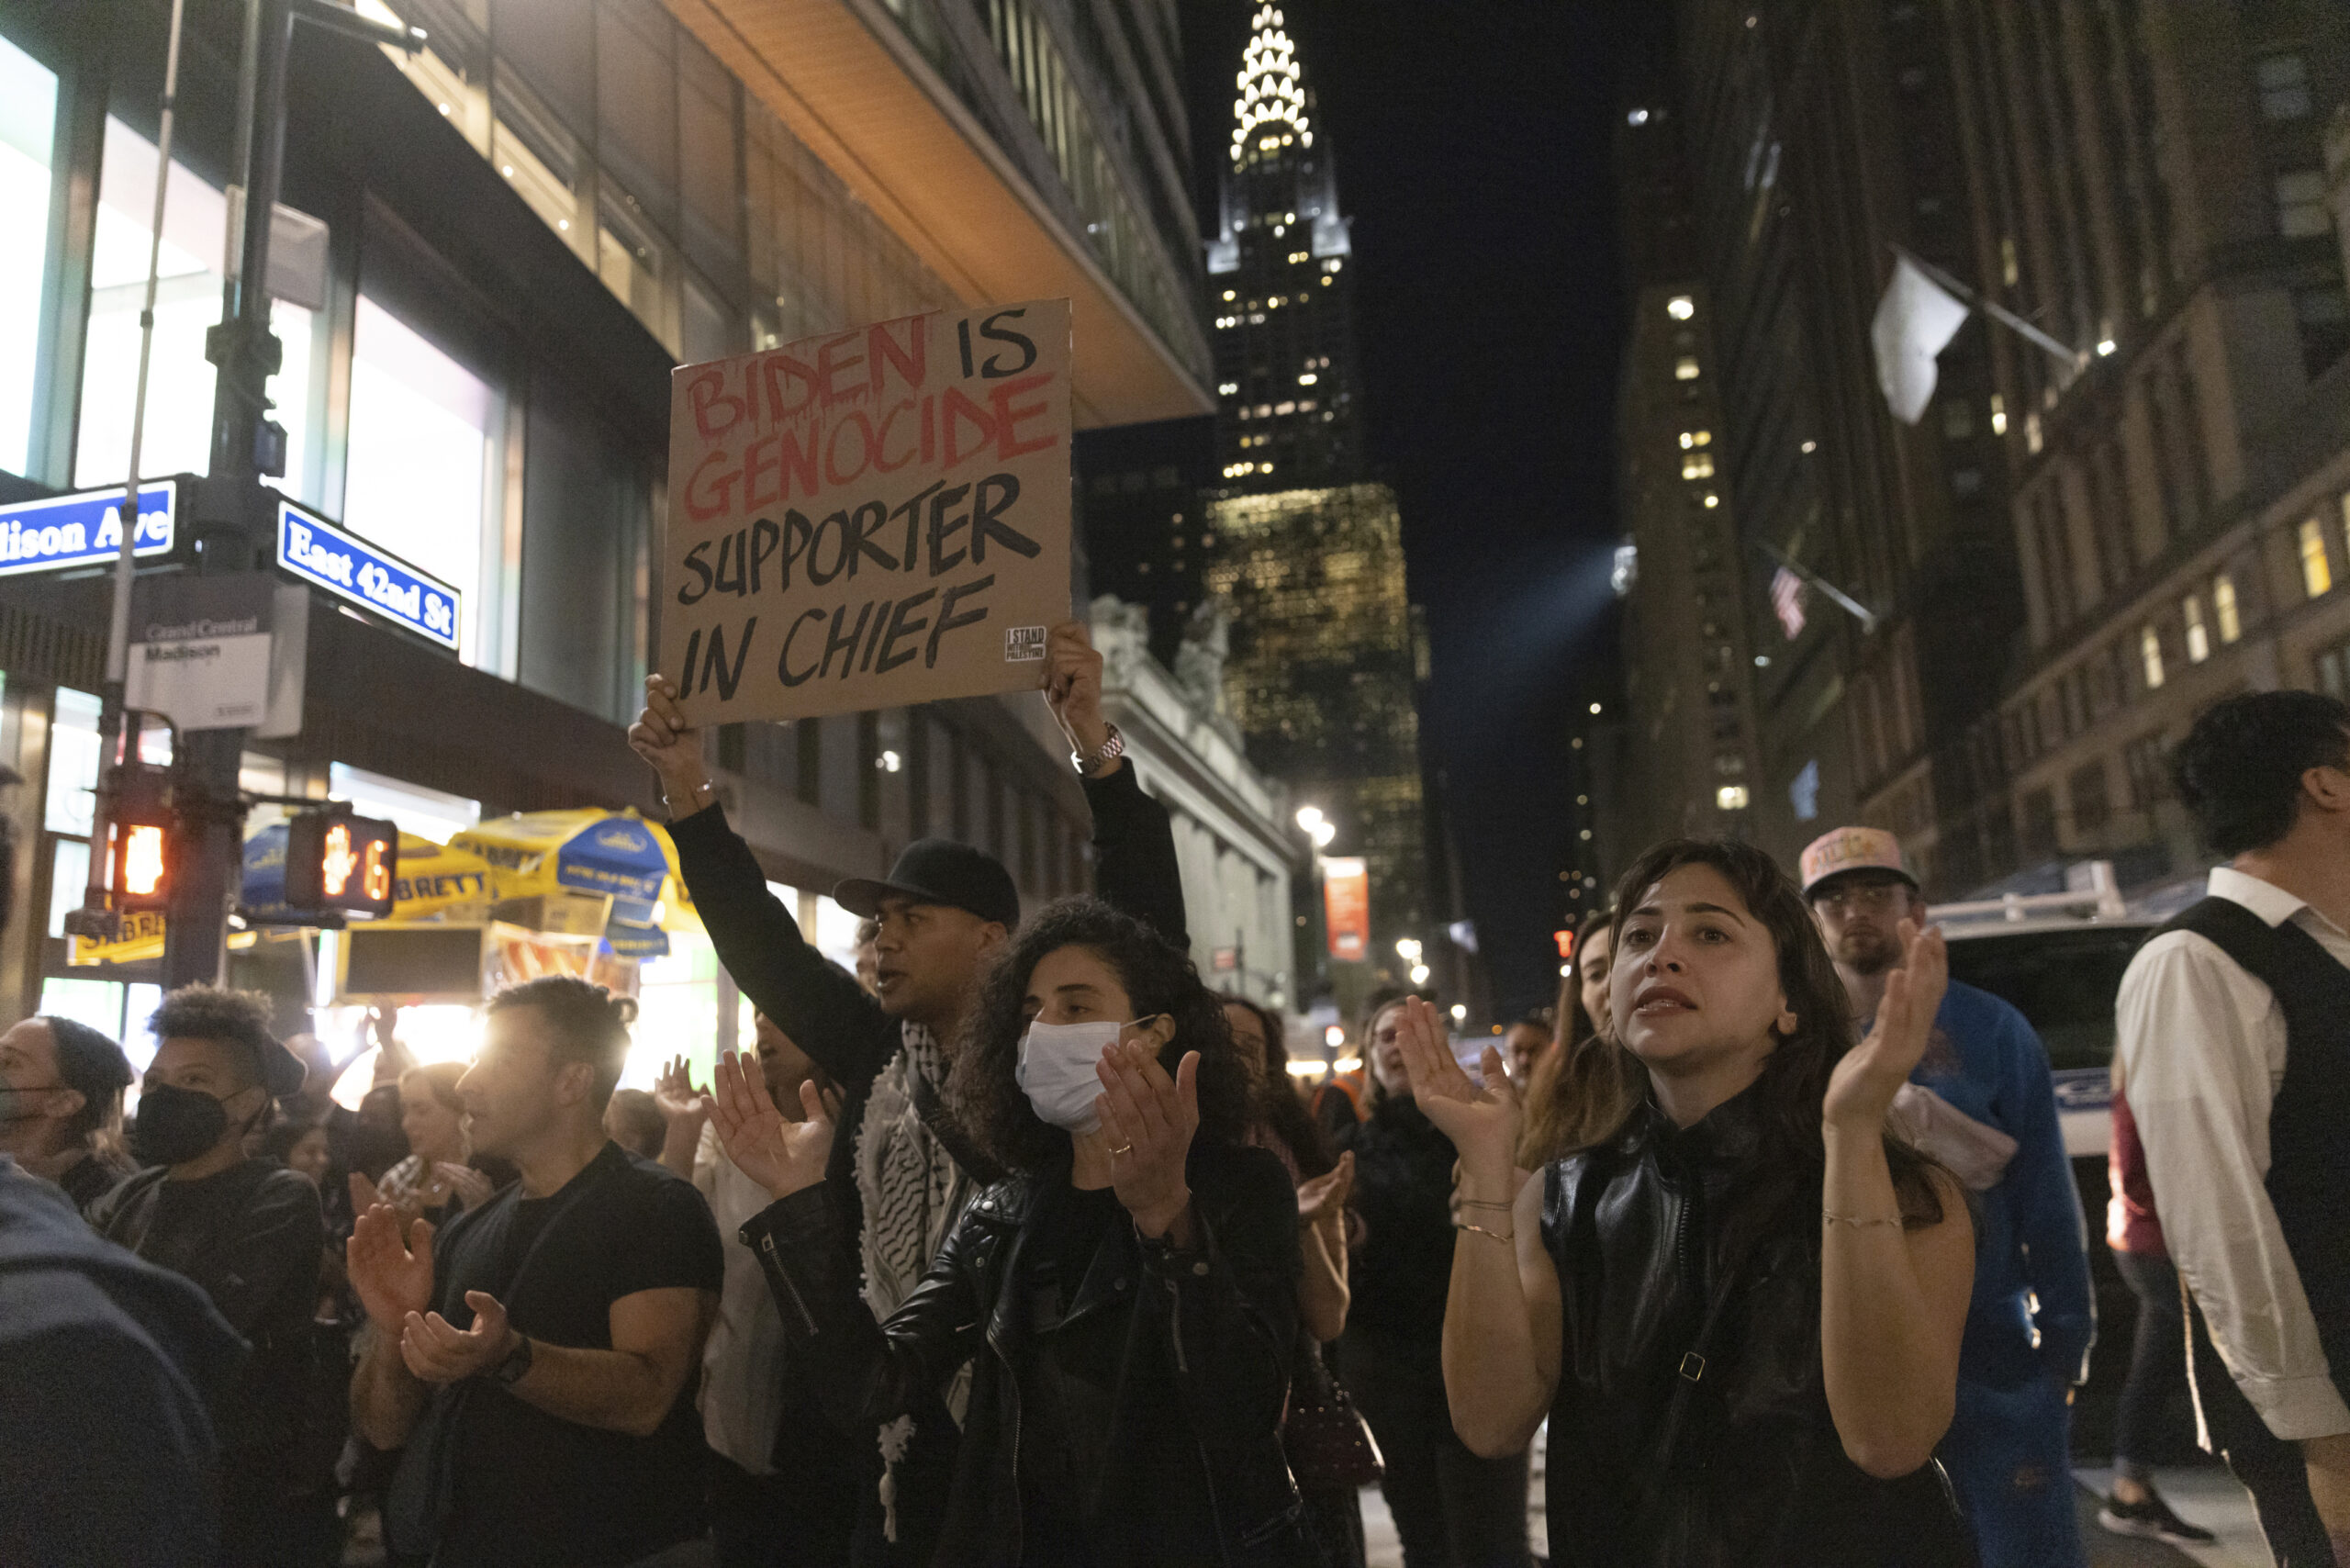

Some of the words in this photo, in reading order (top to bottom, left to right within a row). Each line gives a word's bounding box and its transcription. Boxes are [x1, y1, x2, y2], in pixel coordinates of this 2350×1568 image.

[687, 314, 930, 441] BIDEN
[957, 308, 1038, 378] IS
[684, 371, 1058, 523] GENOCIDE
[94, 507, 169, 548] Ave
[287, 521, 353, 588] East
[356, 561, 421, 621] 42nd
[424, 592, 453, 636] St
[677, 472, 1042, 605] SUPPORTER
[146, 644, 221, 661] Madison
[679, 616, 758, 701] IN
[778, 574, 996, 688] CHIEF
[1007, 630, 1011, 644] I
[1013, 628, 1045, 644] STAND
